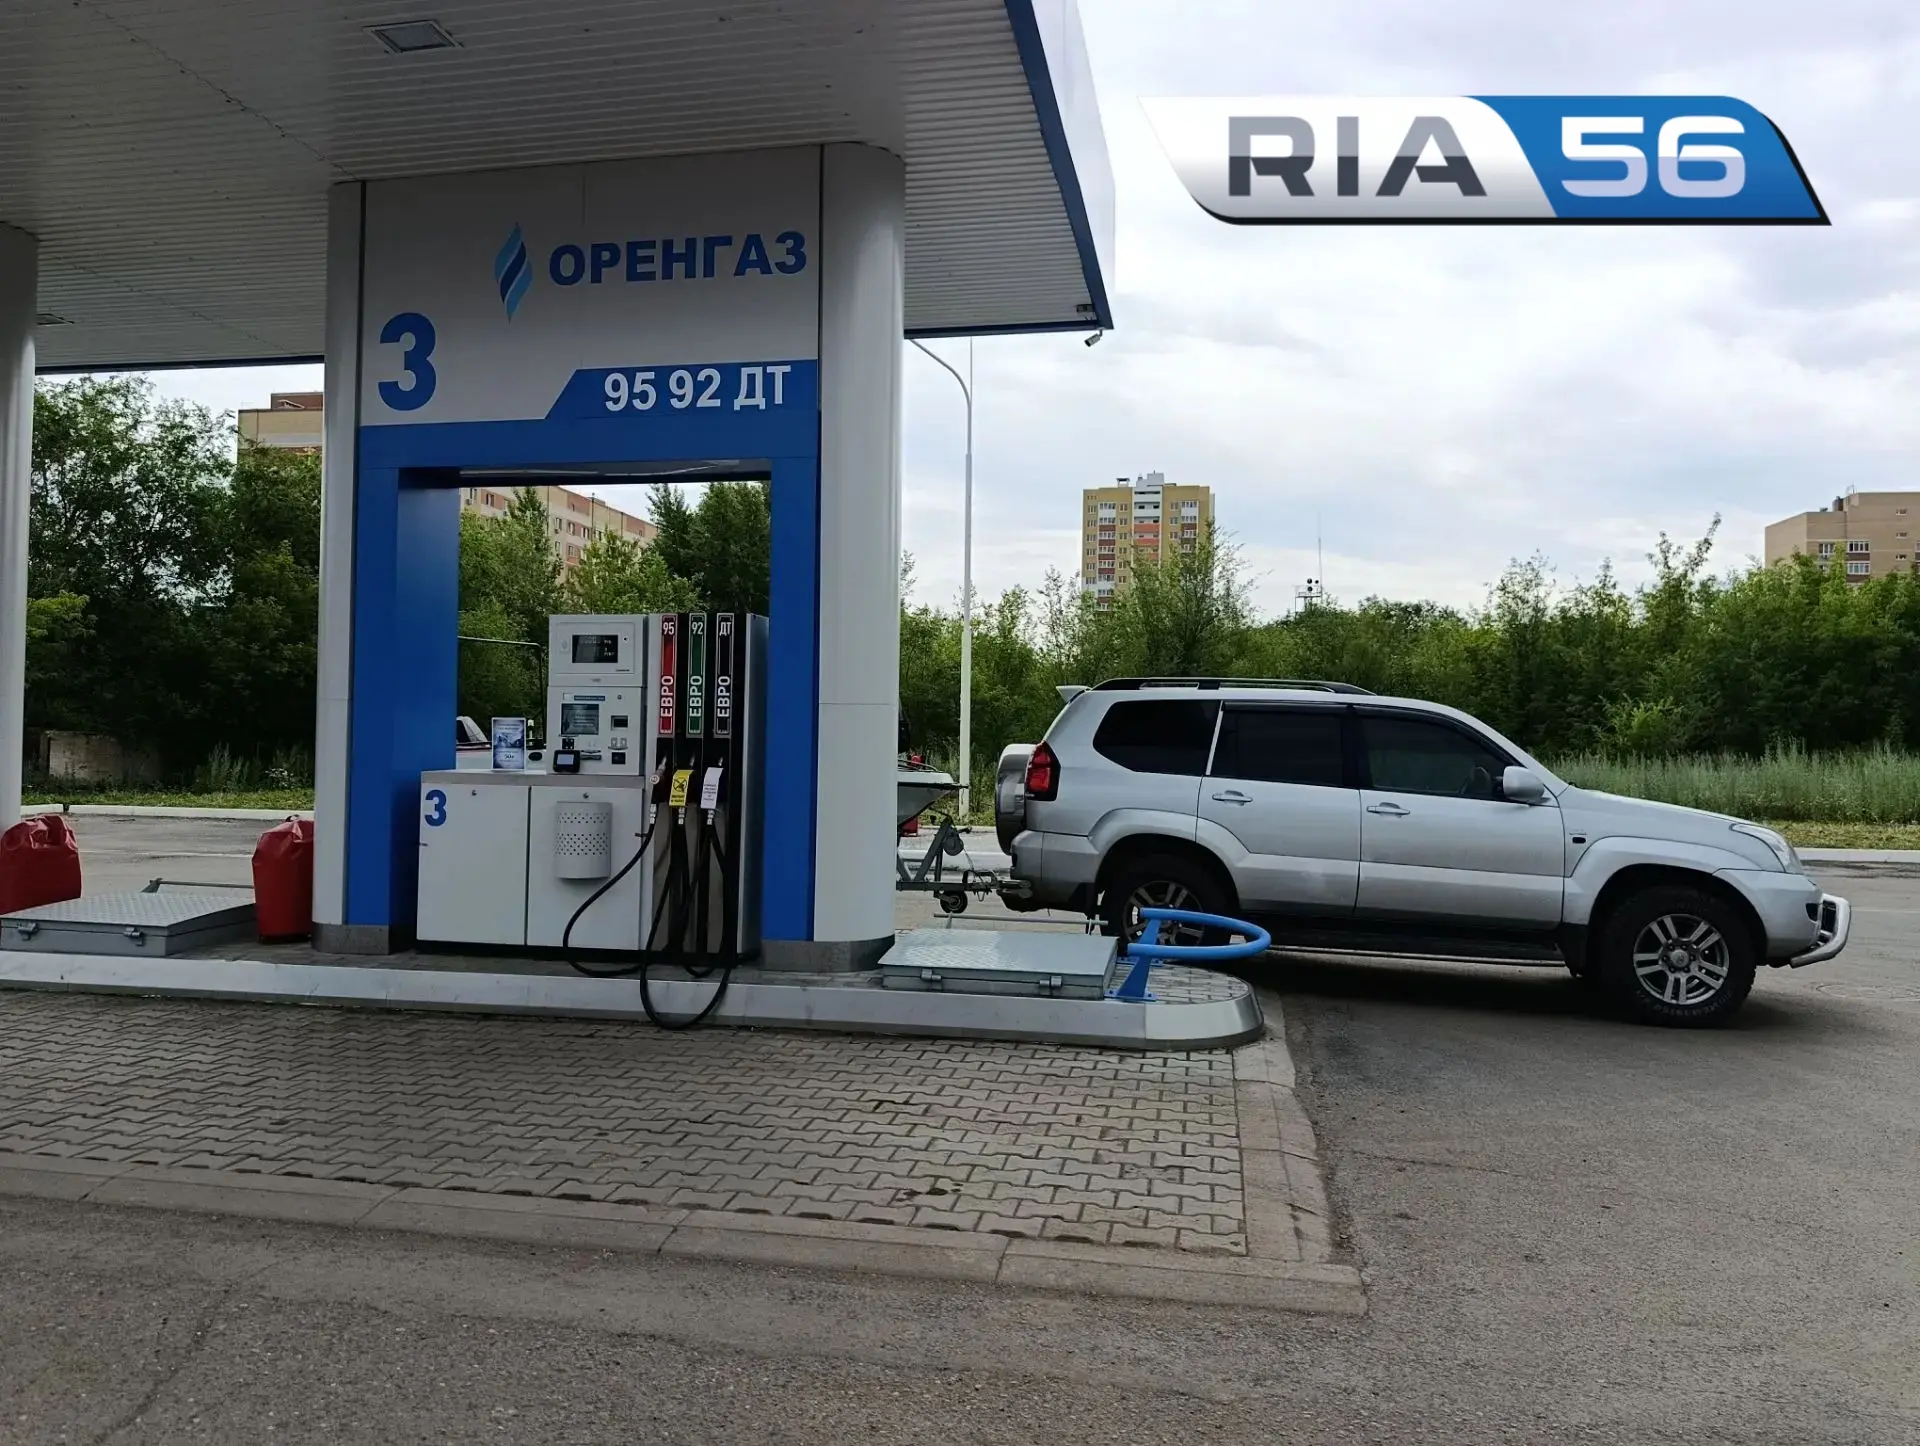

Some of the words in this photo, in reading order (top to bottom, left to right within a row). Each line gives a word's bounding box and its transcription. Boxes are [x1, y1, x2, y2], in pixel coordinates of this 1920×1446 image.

[549, 231, 807, 285] ОРЕНГАЗ
[378, 312, 437, 411] 3
[604, 371, 657, 411] 95
[669, 368, 721, 409] 92
[733, 364, 792, 411] ДТ
[663, 622, 675, 635] 95
[692, 622, 704, 635] 92
[719, 622, 731, 636] ДТ
[661, 676, 673, 717] ЕВРО
[689, 676, 702, 717] ЕВРО
[717, 676, 730, 717] ЕВРО
[424, 789, 447, 827] 3
